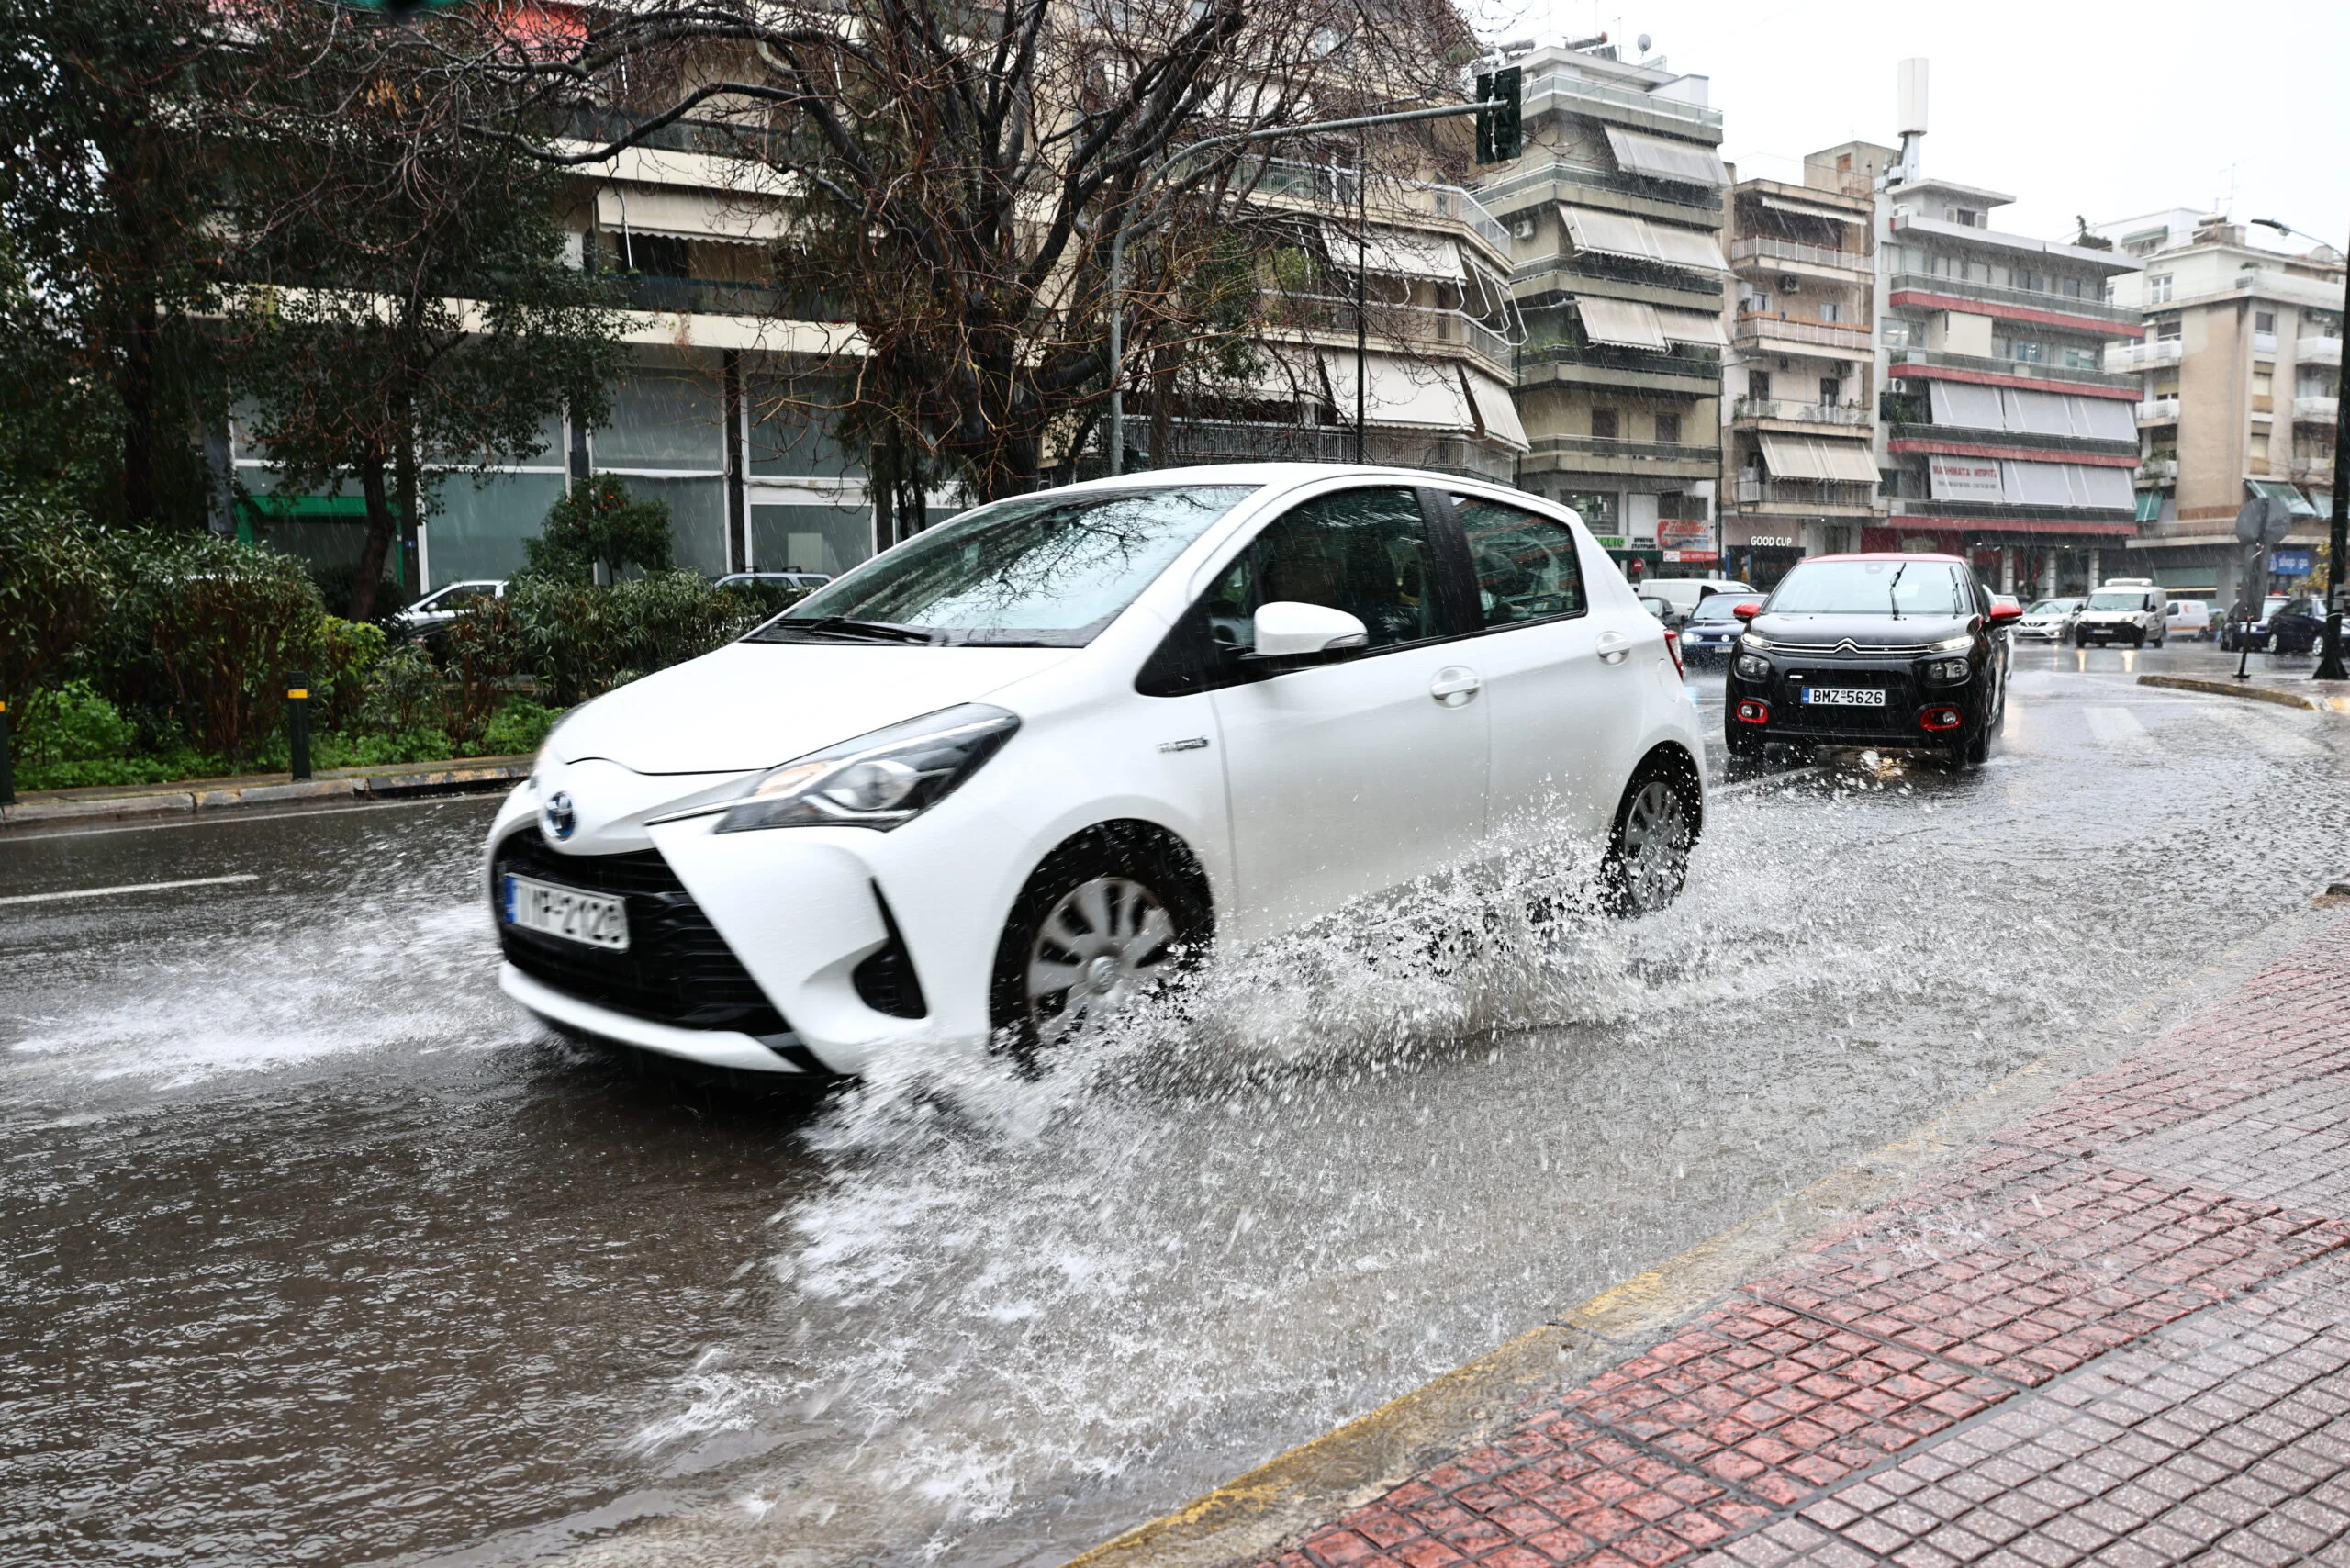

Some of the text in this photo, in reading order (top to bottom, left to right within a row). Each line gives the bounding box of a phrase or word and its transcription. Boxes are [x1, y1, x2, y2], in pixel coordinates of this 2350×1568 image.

[1751, 536, 1792, 546] GOOD CUP
[1813, 689, 1883, 705] BMZ-5626
